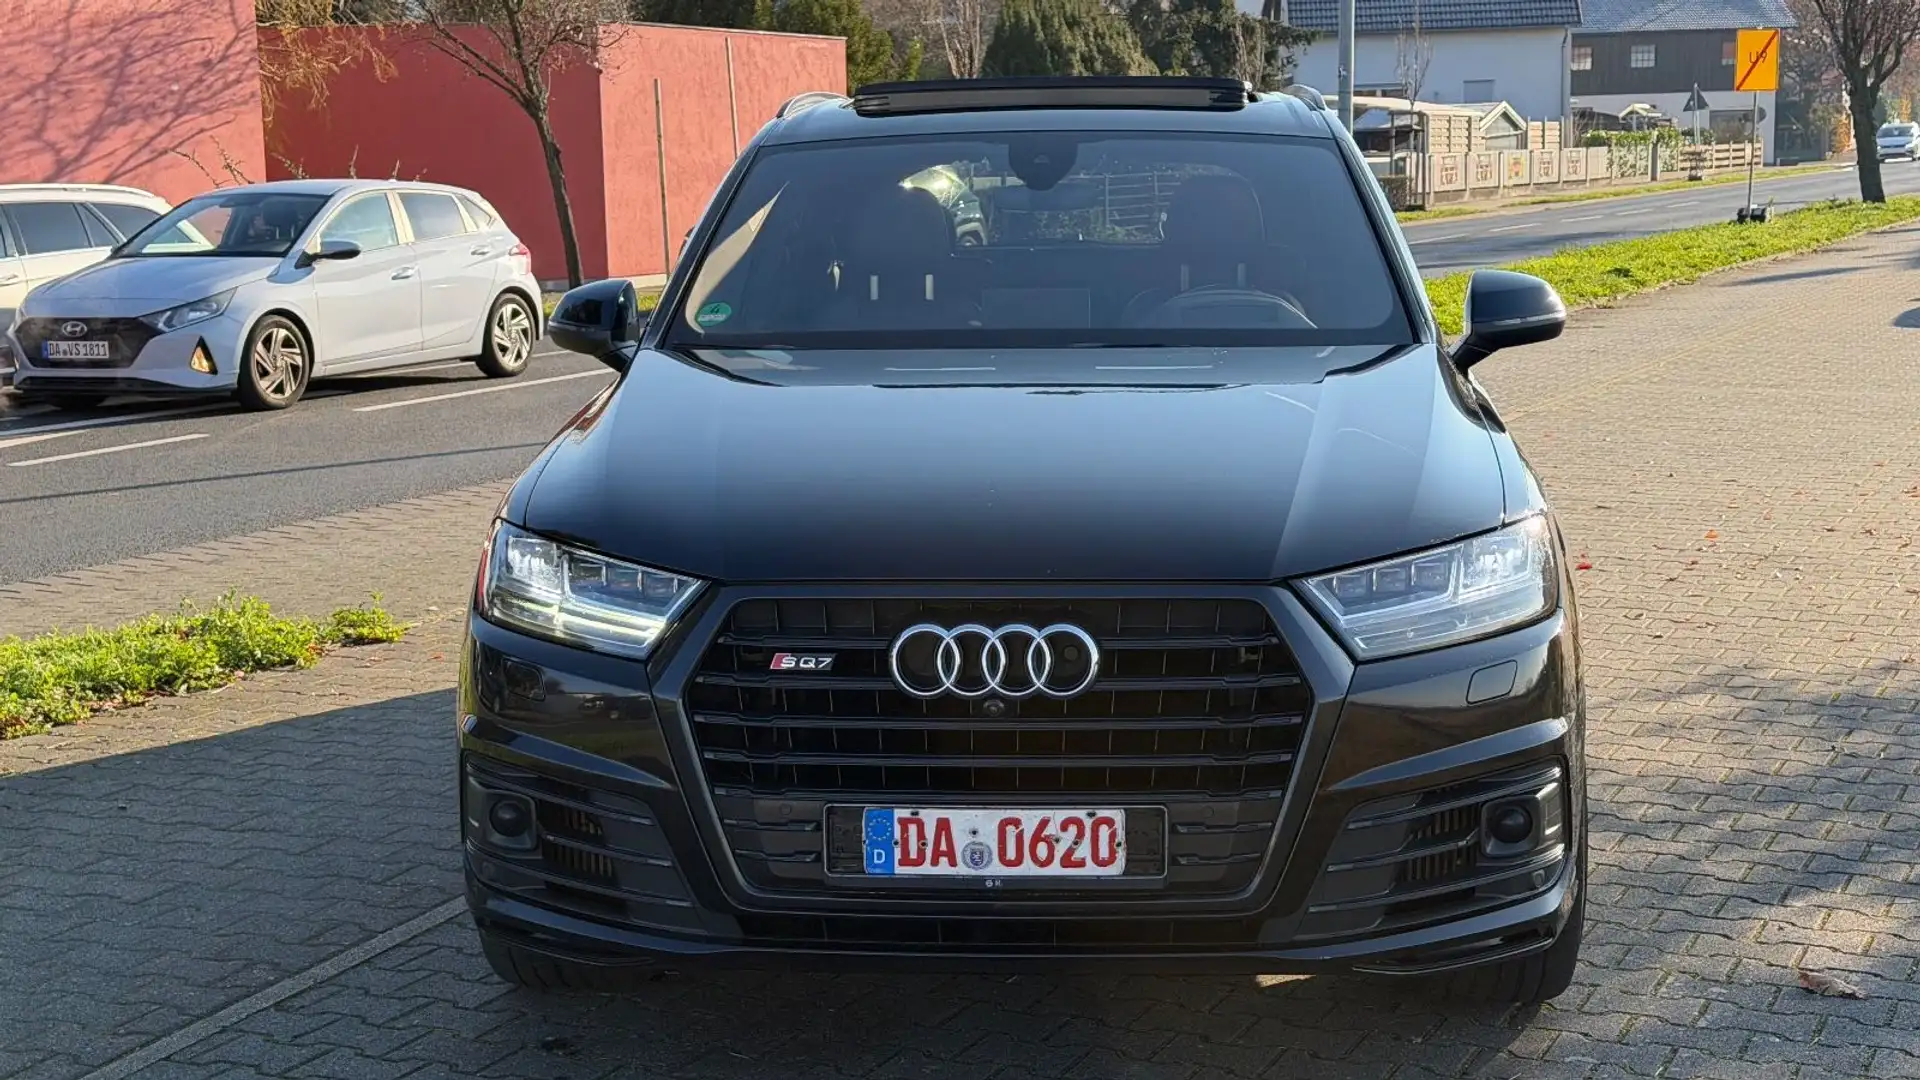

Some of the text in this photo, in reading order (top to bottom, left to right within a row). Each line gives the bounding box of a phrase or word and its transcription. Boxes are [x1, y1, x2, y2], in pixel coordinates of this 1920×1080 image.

[781, 656, 833, 668] SQ7
[897, 817, 958, 868] DA
[997, 816, 1118, 869] 0620
[873, 849, 886, 864] D
